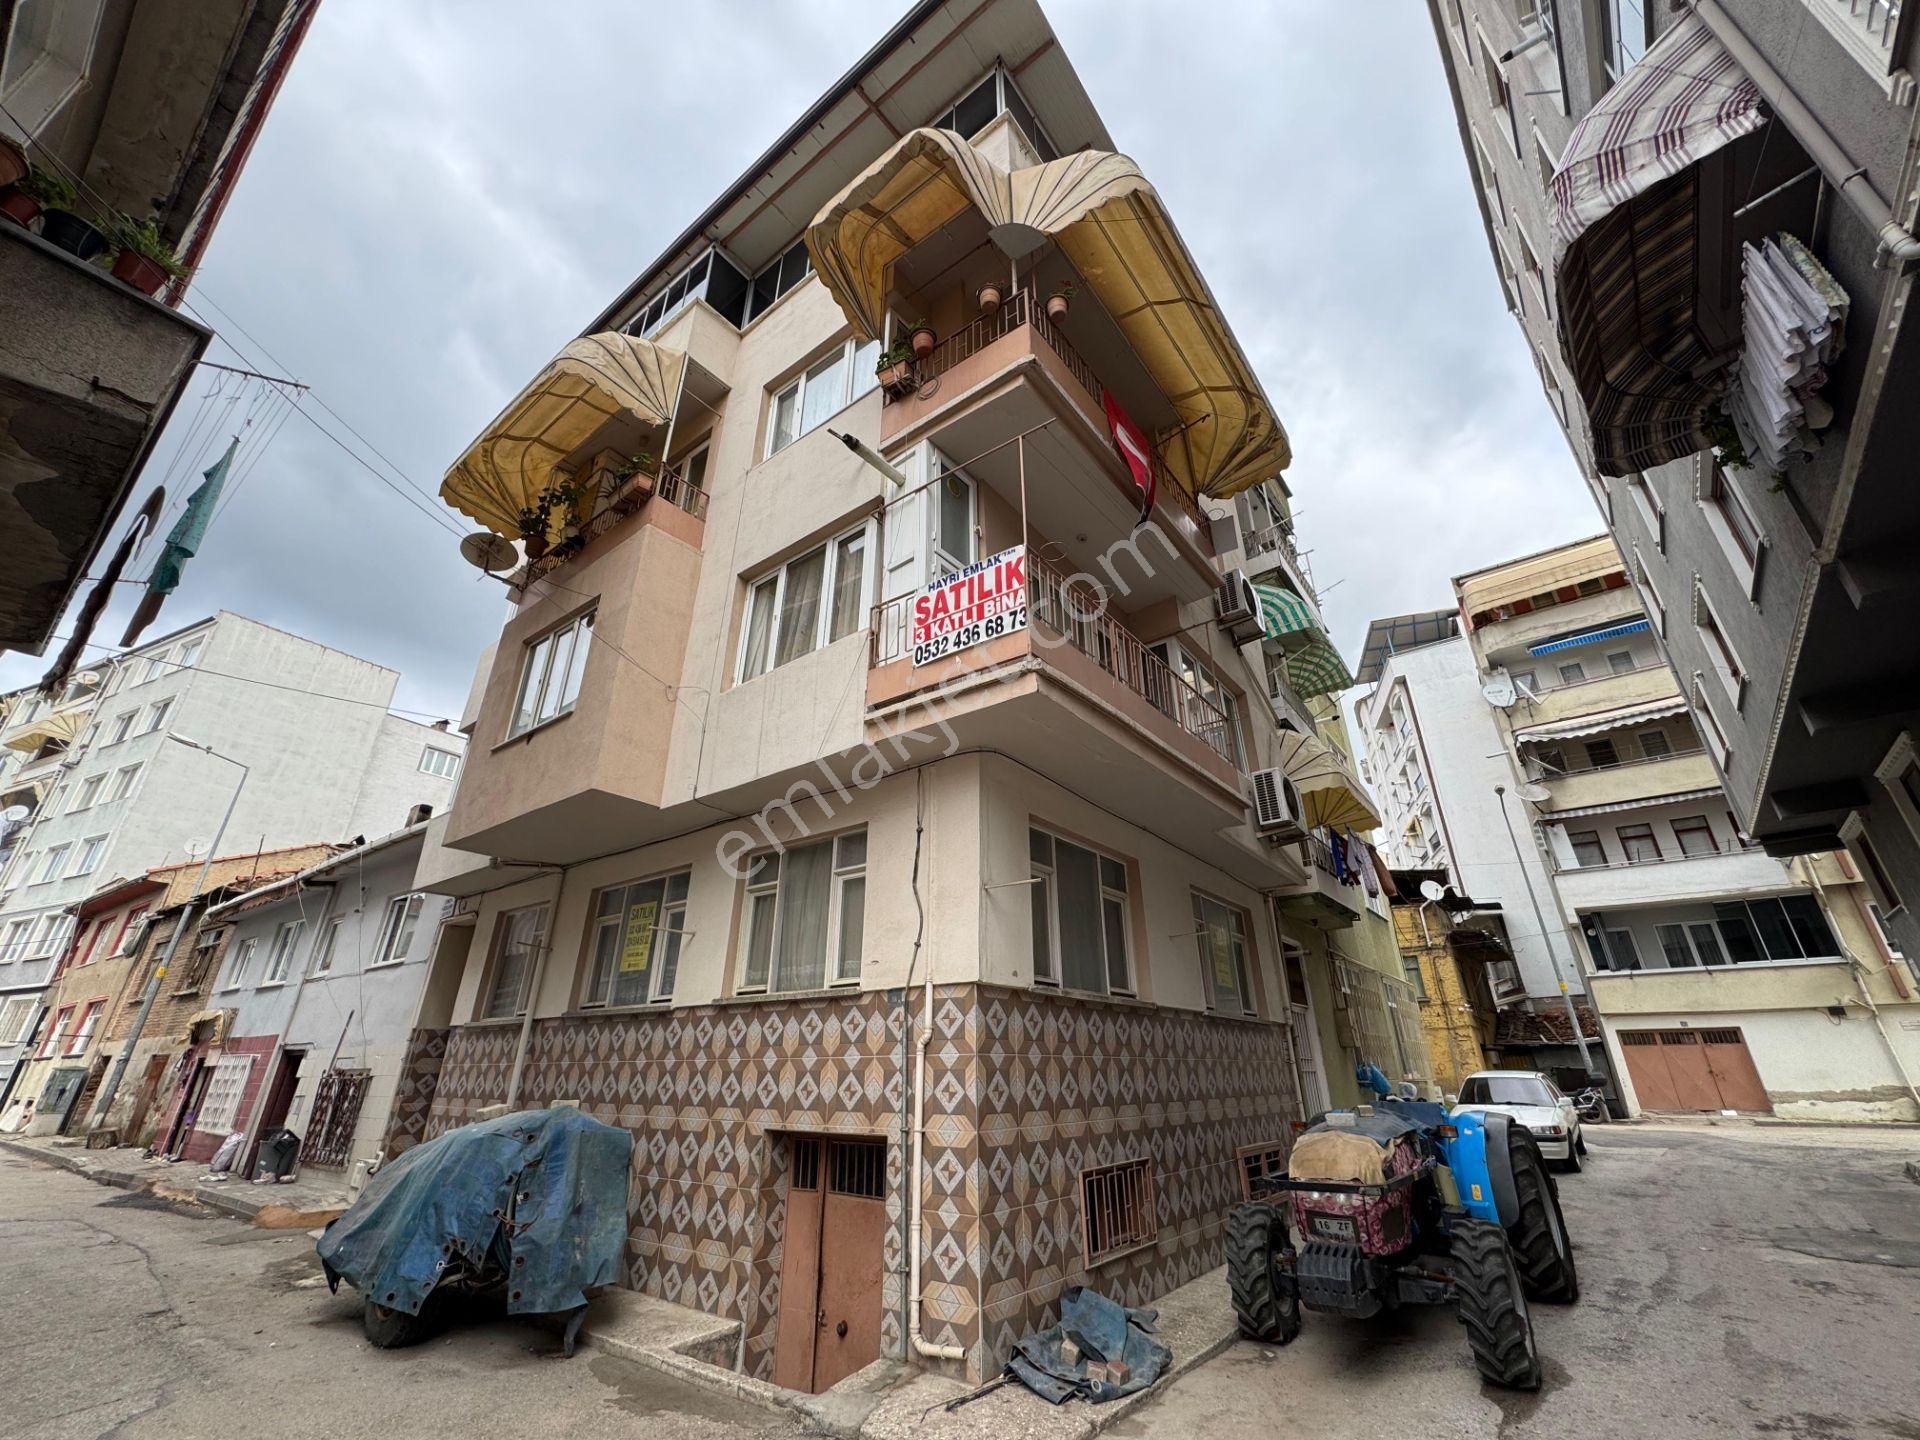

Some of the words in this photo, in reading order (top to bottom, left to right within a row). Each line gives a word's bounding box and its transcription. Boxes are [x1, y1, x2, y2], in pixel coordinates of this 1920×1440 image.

[915, 555, 1026, 627] SATILIK
[914, 635, 949, 665] 0532
[953, 624, 981, 650] 436
[985, 615, 1005, 638] 68
[1008, 606, 1027, 630] 73
[915, 626, 926, 644] 3
[930, 609, 979, 639] KATLI
[1318, 1220, 1330, 1230] 16
[1337, 1221, 1350, 1231] ZF
